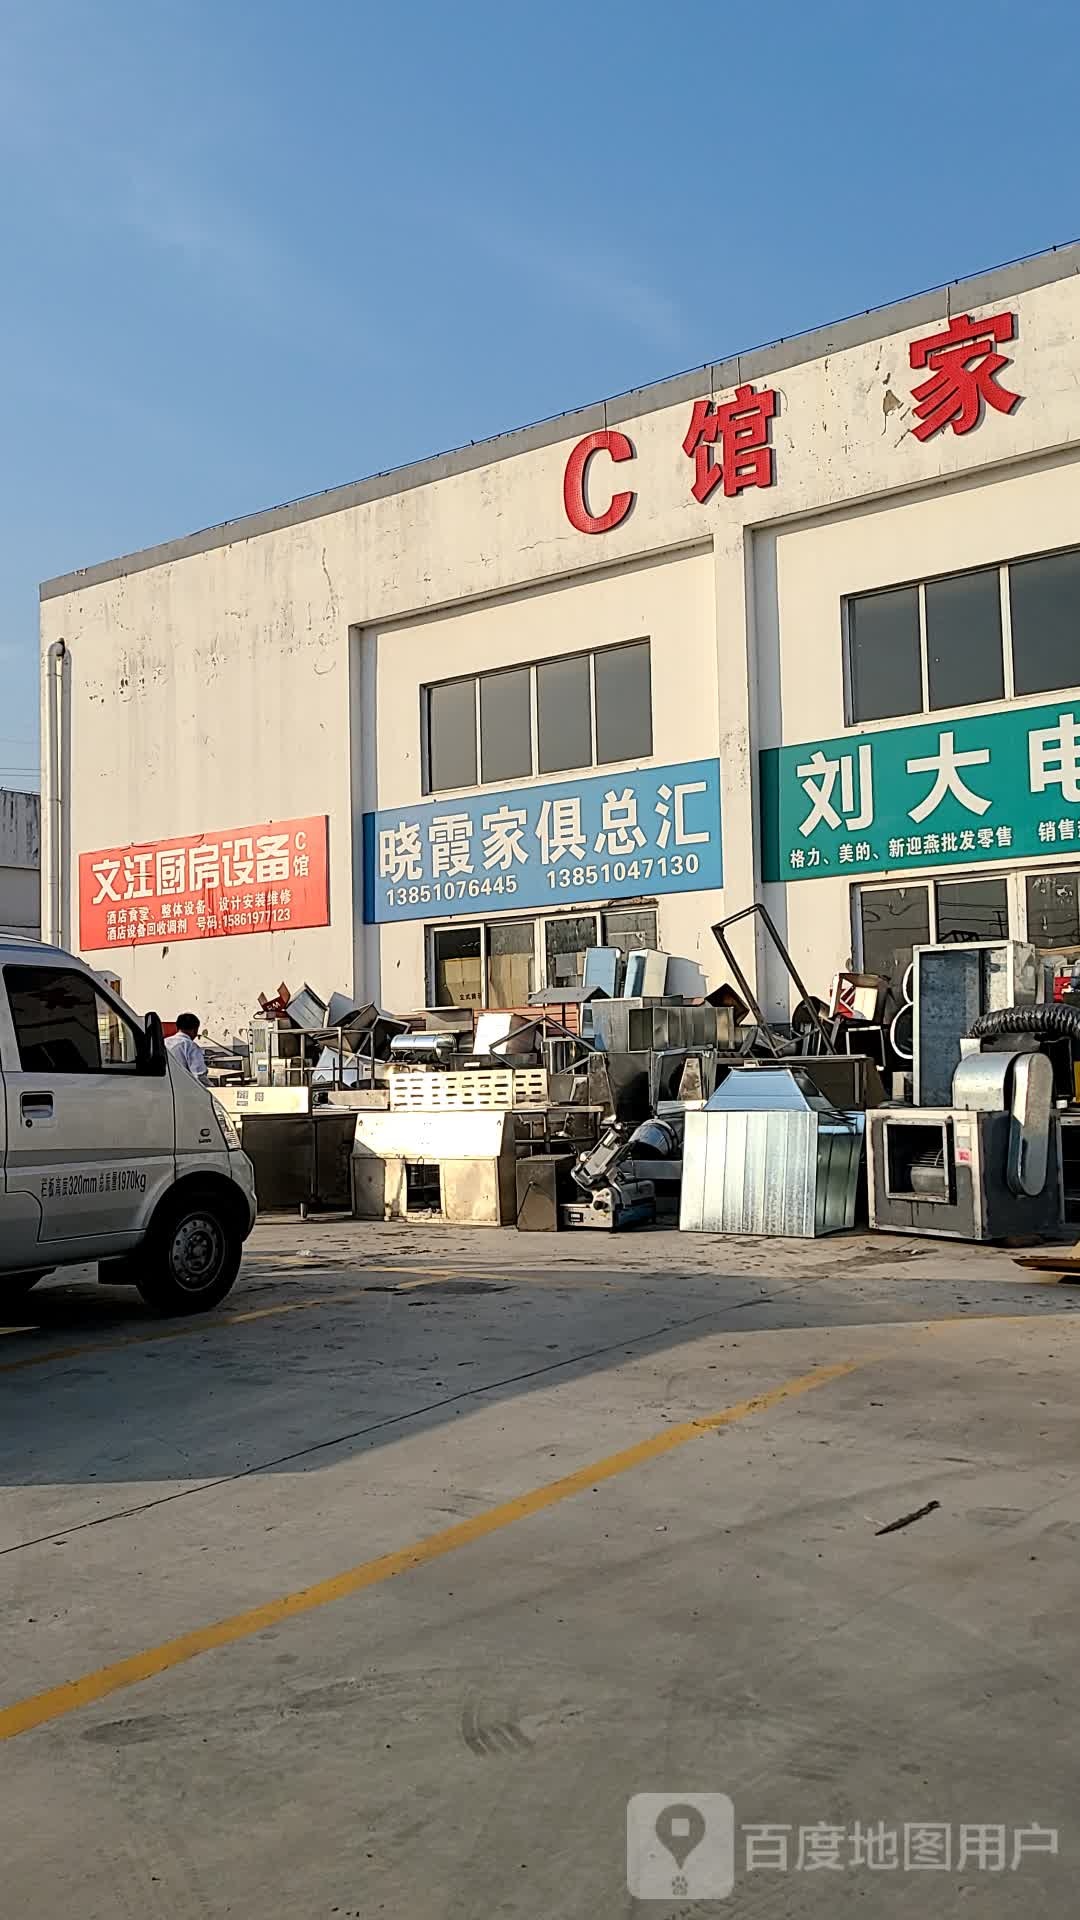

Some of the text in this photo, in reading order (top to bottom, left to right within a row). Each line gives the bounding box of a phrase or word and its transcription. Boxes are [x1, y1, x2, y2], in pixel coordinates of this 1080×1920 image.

[379, 780, 710, 884] 晓霞家俱总汇
[1038, 817, 1080, 843] 销售
[91, 834, 290, 905] 文江厨房设备
[386, 853, 700, 906] 13851076445 13851047130
